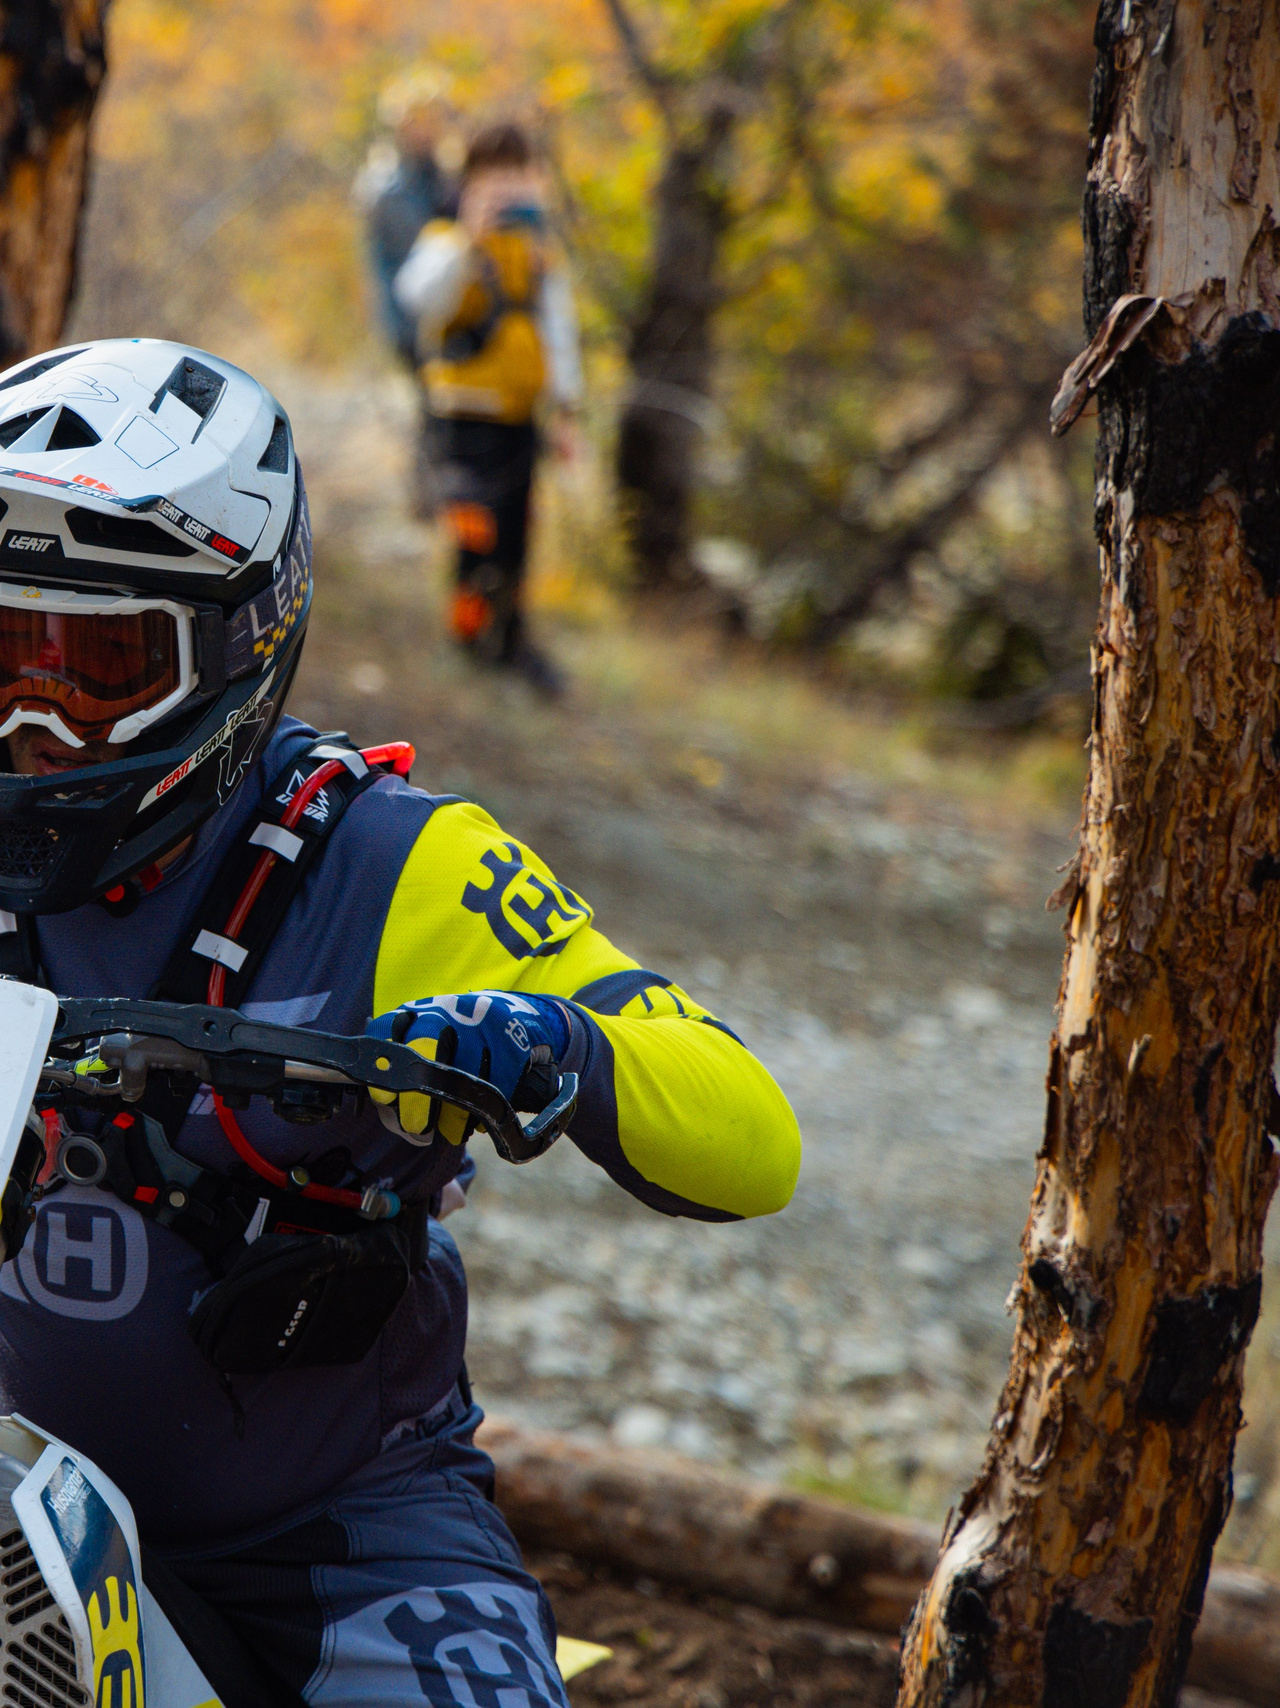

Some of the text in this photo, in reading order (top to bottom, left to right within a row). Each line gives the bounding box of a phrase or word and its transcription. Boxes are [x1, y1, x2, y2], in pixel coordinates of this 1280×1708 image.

[67, 484, 120, 500] LEATT
[8, 535, 56, 552] LEATT
[157, 499, 240, 557] LEATT LEATT LEATT
[156, 690, 260, 796] LEATT LEATT LEATT
[47, 1466, 84, 1516] Husqvarna
